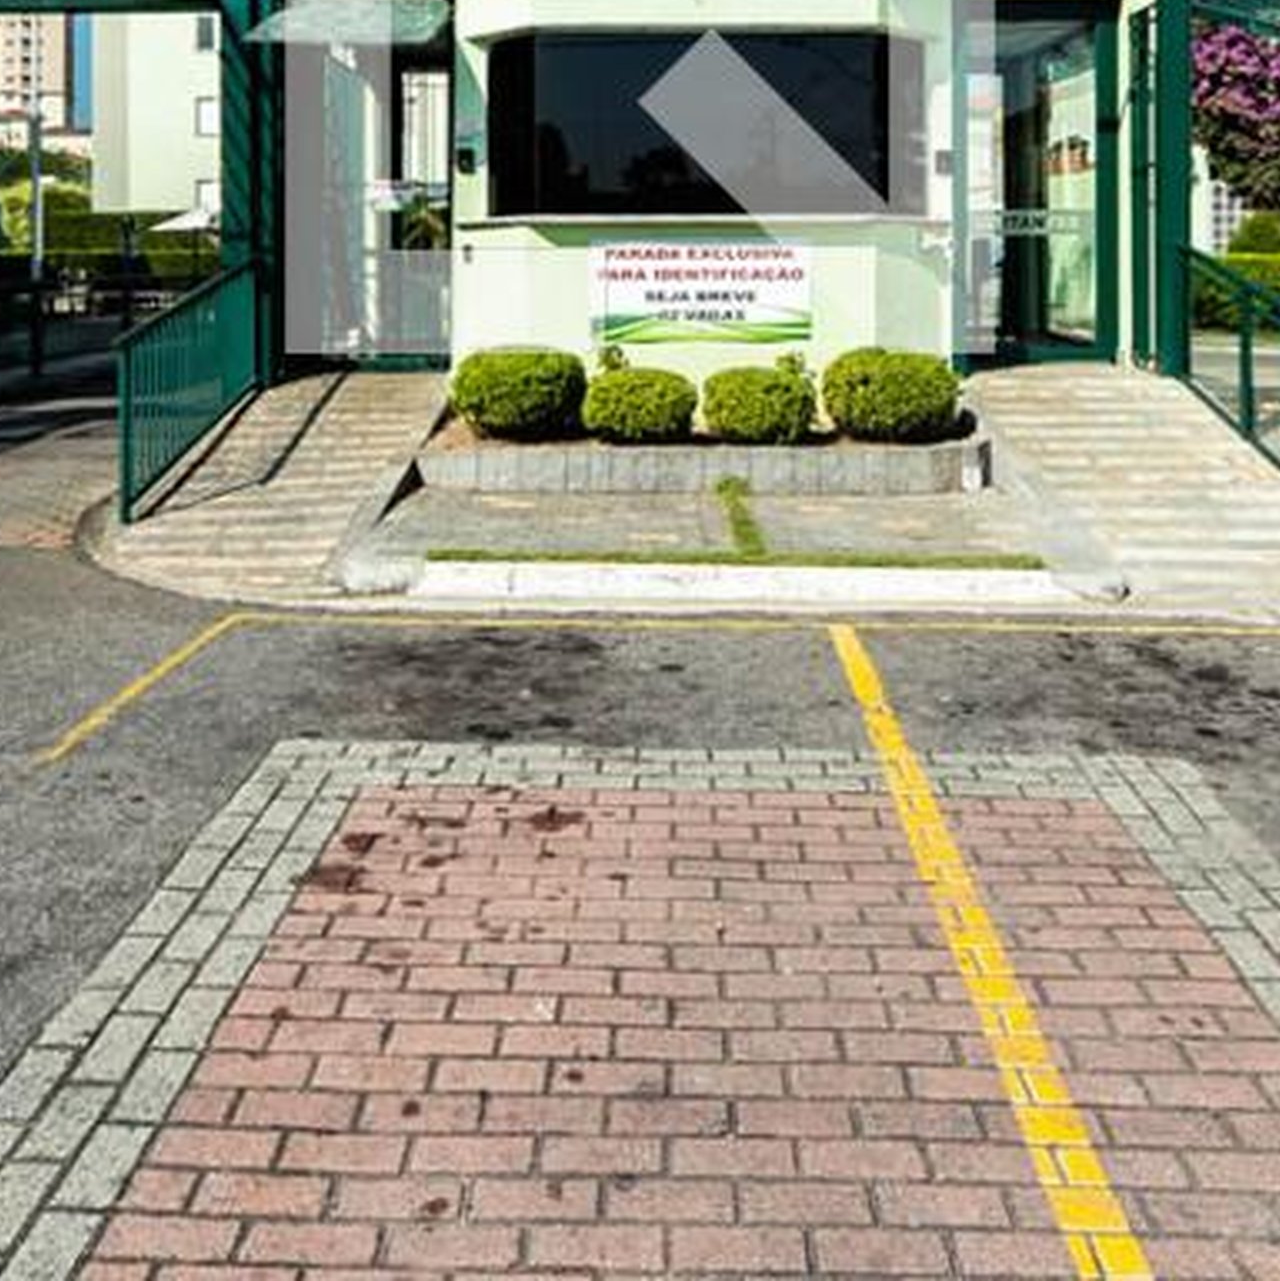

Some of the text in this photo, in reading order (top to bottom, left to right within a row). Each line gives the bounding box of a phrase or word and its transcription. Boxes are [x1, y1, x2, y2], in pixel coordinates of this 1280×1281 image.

[603, 248, 794, 261] PARADA EXCLUSIVA
[596, 265, 805, 284] PARA IDENTIFICAÇÃO
